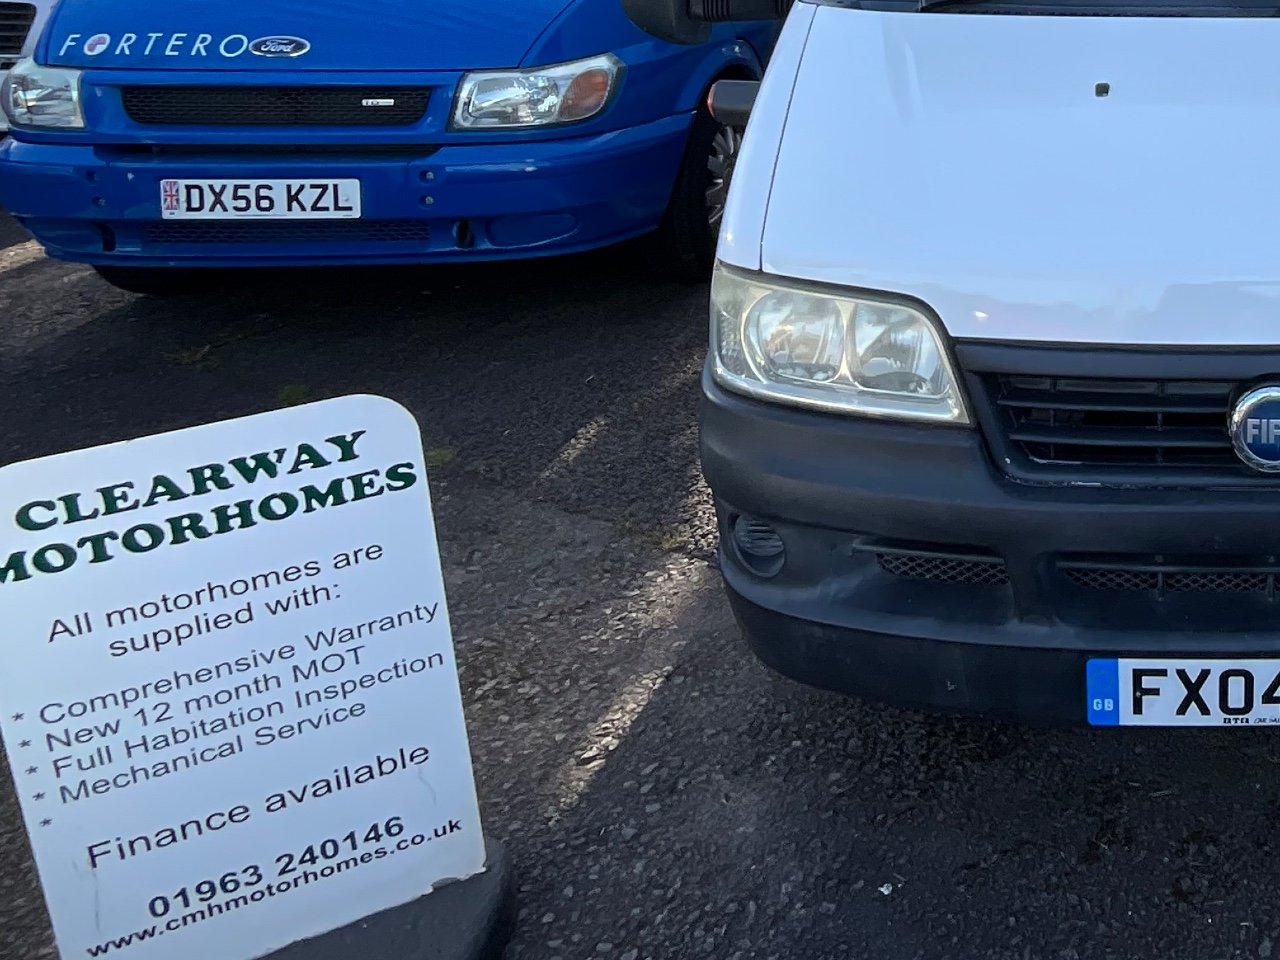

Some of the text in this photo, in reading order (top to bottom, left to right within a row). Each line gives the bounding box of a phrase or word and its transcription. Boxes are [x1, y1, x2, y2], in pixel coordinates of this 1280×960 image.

[58, 33, 249, 58] FORTERO
[184, 183, 353, 213] DX56 KZL
[15, 430, 367, 532] CLEARWAY
[48, 544, 384, 644] All motorhomes are
[109, 584, 342, 657] supplied with:
[39, 602, 439, 724] Comprehensive Warranty
[46, 645, 366, 752] New 12 month MOT
[1093, 698, 1114, 711] GB
[53, 652, 444, 779] Full Habitation Inspection
[59, 702, 367, 804] Mechanical Service
[87, 746, 430, 869] Finance available
[86, 818, 463, 958] www.cmhmotorhomes.co.uk
[148, 815, 405, 919] 01963 240146
